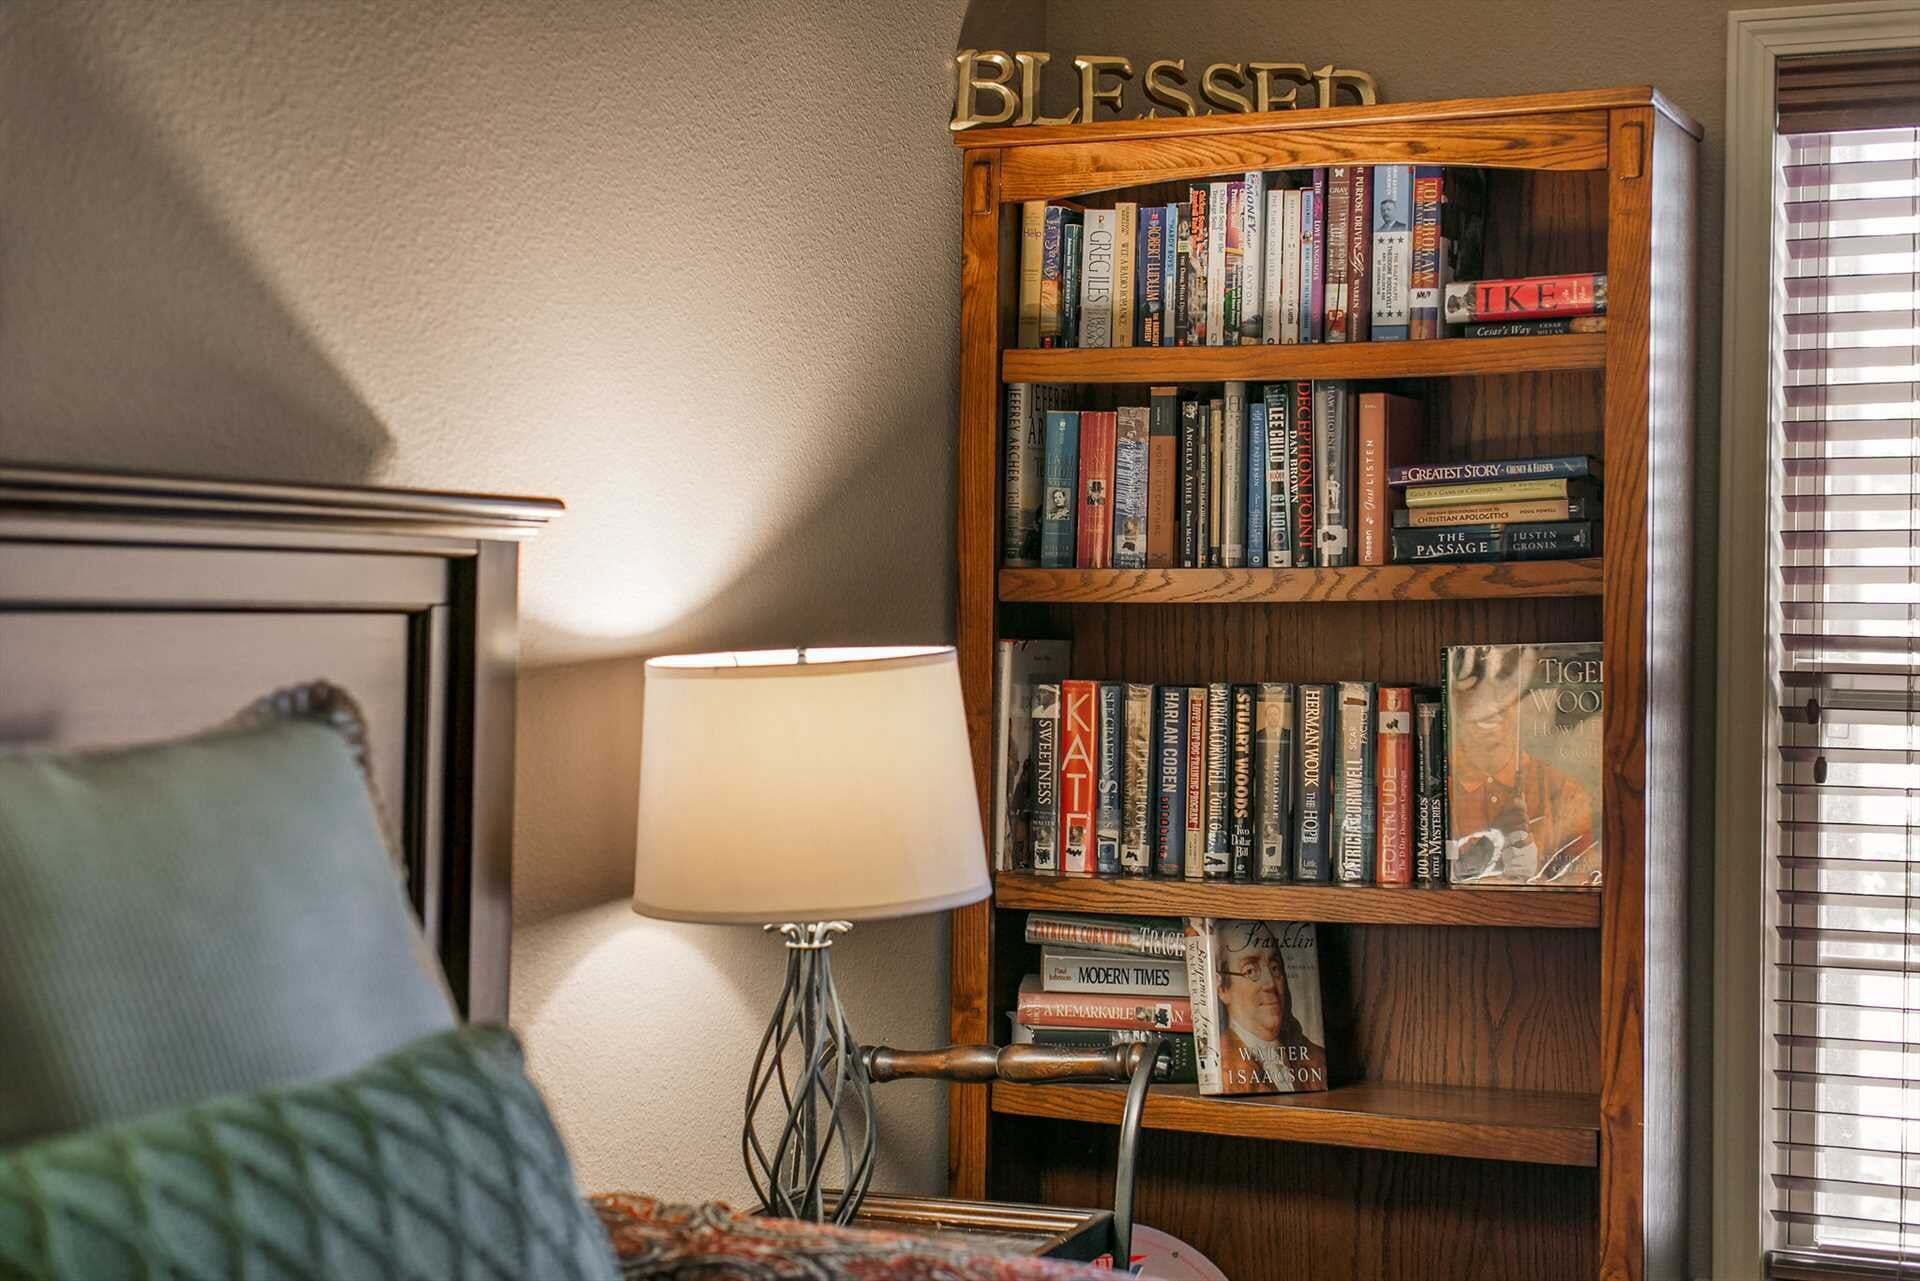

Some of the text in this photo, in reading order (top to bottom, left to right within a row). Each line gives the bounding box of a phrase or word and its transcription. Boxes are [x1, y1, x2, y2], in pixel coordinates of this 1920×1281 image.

[951, 48, 1376, 130] BLESSED
[1219, 190, 1227, 214] Chicken
[1247, 184, 1257, 232] MONEY
[1354, 177, 1364, 212] PURPOSE
[1423, 180, 1439, 214] TOM
[1216, 216, 1226, 232] Soup
[1313, 219, 1322, 238] LOVE
[1353, 216, 1364, 247] DRIVEN
[1414, 196, 1423, 236] GREATEST
[1088, 231, 1112, 273] GREG
[1147, 226, 1161, 259] ROBERT
[1218, 233, 1226, 242] for
[1422, 218, 1437, 284] BROKAW
[1087, 276, 1111, 303] ILES
[1145, 263, 1160, 302] LUDLUM
[1352, 280, 1360, 309] WARREN
[1094, 316, 1106, 348] BLOO
[1475, 324, 1532, 338] Cesar's Way
[1008, 388, 1023, 432] JEFFREY
[1269, 406, 1286, 432] LEE
[1007, 437, 1021, 483] ARCHER
[1185, 426, 1196, 472] ANGELA'S
[1269, 431, 1285, 464] CHILD
[1365, 439, 1375, 485] LISTEN
[1289, 430, 1299, 506] DAN BROWN
[1298, 382, 1314, 549] DECEPTION POINT
[1408, 465, 1464, 481] GREATEST
[1463, 463, 1502, 479] STORY
[1184, 474, 1195, 505] ASHES
[1417, 511, 1510, 525] CHRISTIAN APOLOGETICS
[1416, 542, 1488, 558] PASSAGE
[1438, 530, 1558, 542] THE JUSTIN
[1105, 691, 1117, 715] SUE
[1162, 692, 1180, 745] HARLAN
[1190, 723, 1201, 741] THAT
[1038, 719, 1054, 806] SWEETNESS
[1190, 743, 1200, 756] DOG
[1208, 689, 1228, 821] PATRICIA CORNWELL Point
[1234, 693, 1251, 819] STUART WOODS
[1161, 748, 1178, 794] COBEN
[1189, 757, 1201, 790] TRAINING
[1302, 690, 1320, 843] HERMAN WOUK THE HOPE
[1344, 758, 1364, 820] CORNWELL
[1381, 767, 1398, 876] FORTITUDE
[1416, 796, 1431, 858] MALICIOUS
[1428, 798, 1443, 878] LITTLE MYSTERIES
[1416, 858, 1430, 880] 100
[1224, 921, 1315, 953] Franklin
[1077, 965, 1172, 988] MODERN TIMES
[1195, 942, 1210, 1009] Benjamin
[1055, 1003, 1133, 1021] REMARKABLE
[1238, 1045, 1311, 1063] WALTER
[1228, 1067, 1324, 1085] ISAACSON
